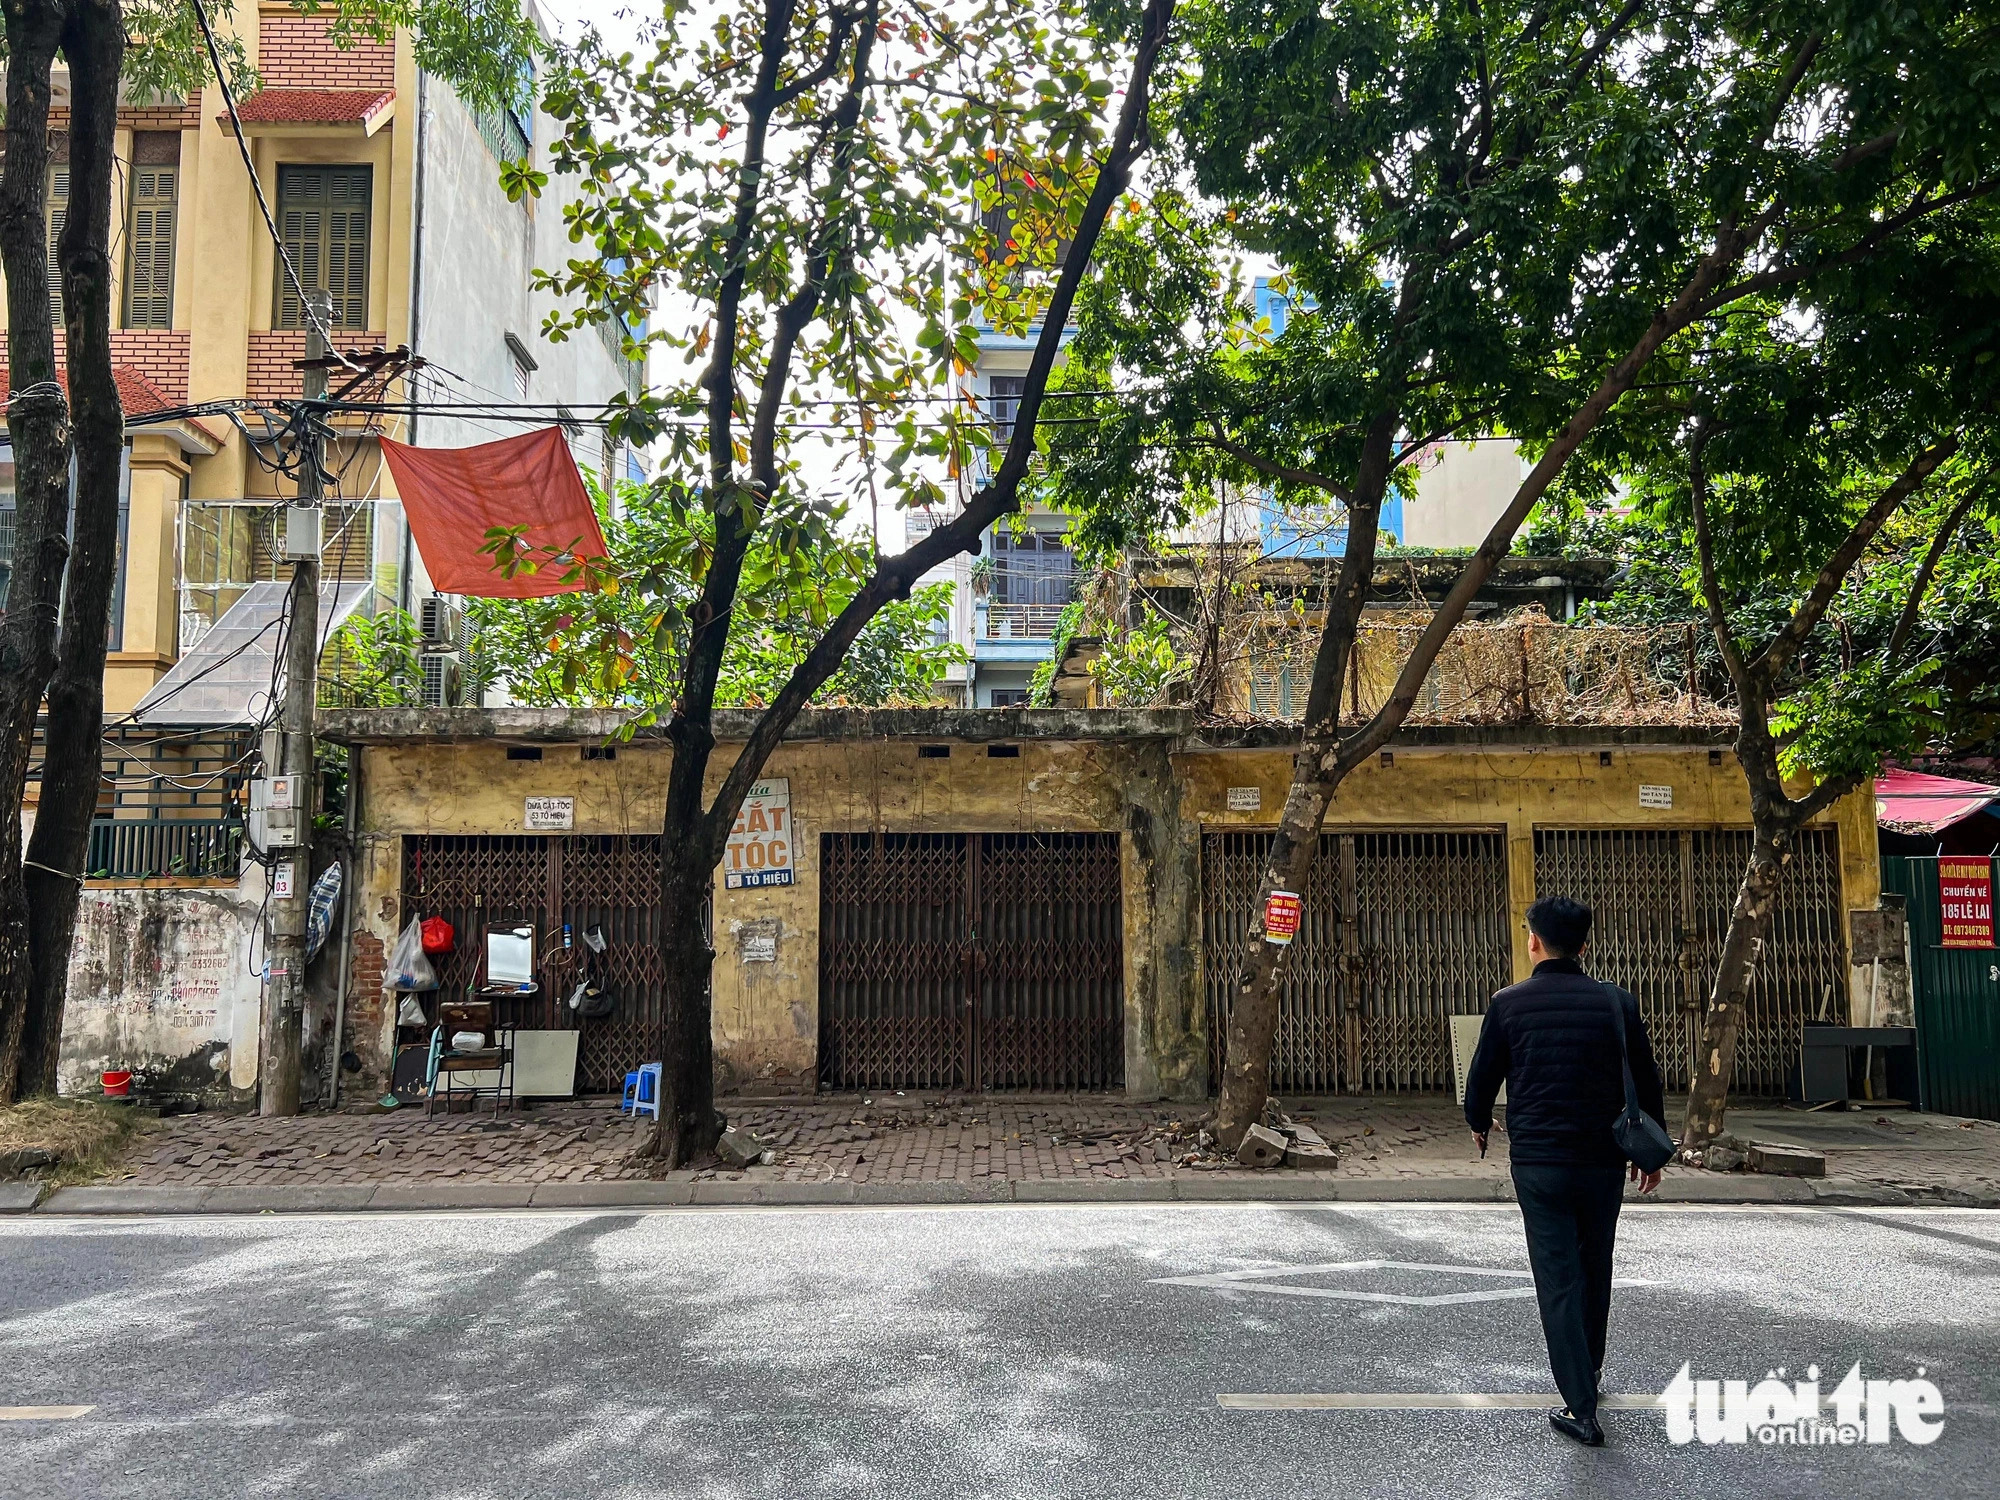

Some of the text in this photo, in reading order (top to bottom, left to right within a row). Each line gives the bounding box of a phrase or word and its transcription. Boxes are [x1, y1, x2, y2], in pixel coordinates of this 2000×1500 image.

[727, 836, 788, 869] TÓC
[276, 881, 287, 892] 03
[763, 871, 789, 886] HIỆU
[1942, 901, 1990, 919] 185 LÊ LAI
